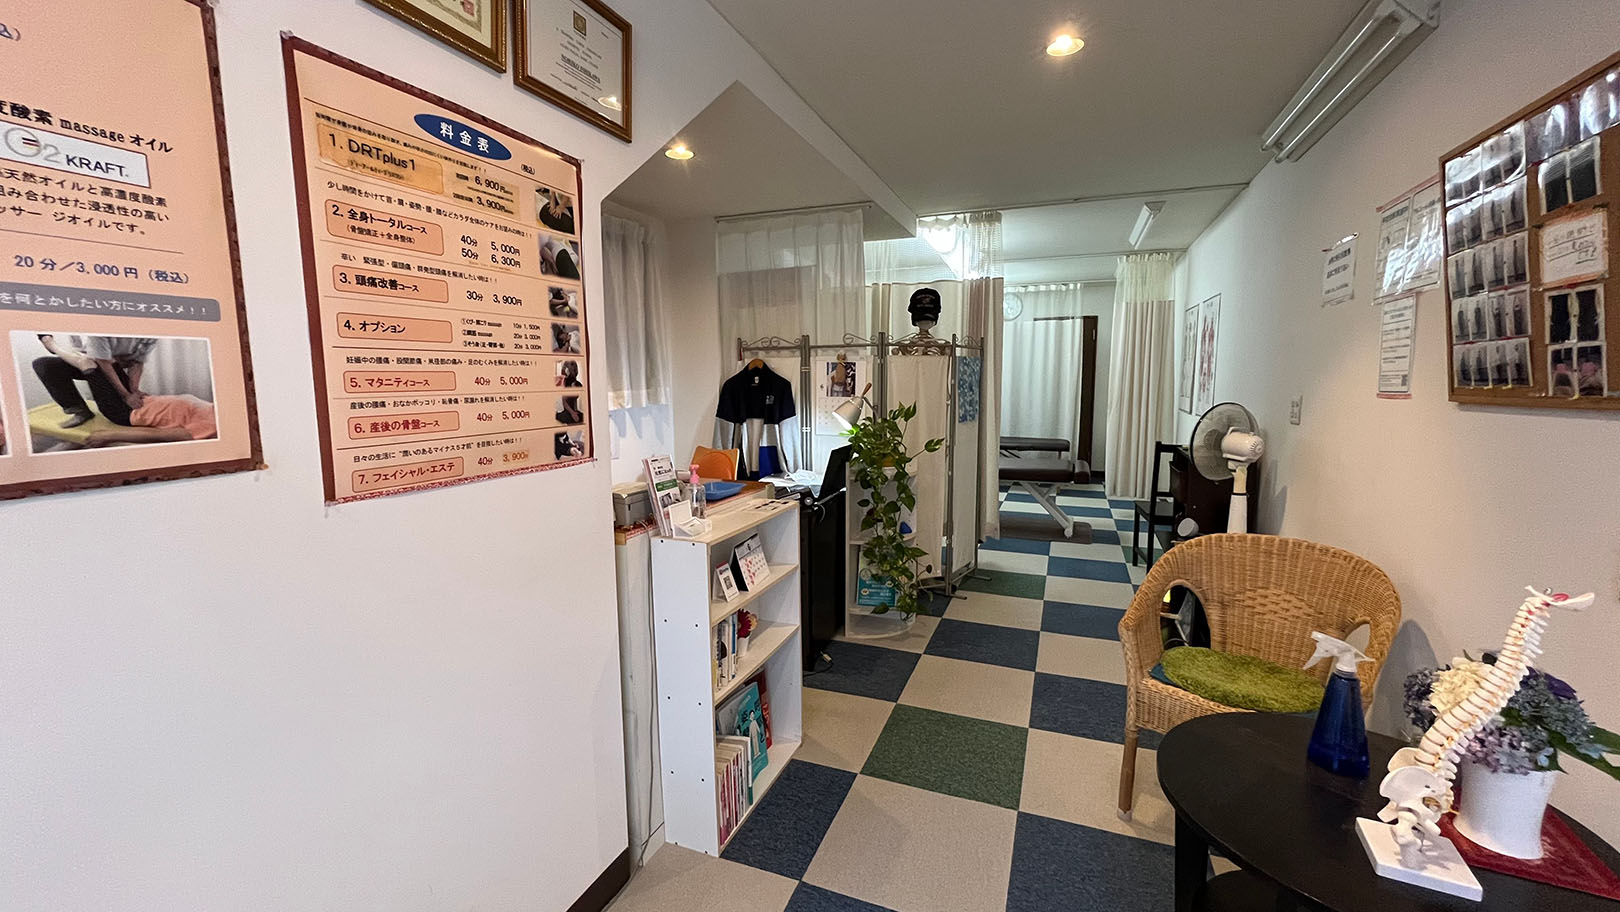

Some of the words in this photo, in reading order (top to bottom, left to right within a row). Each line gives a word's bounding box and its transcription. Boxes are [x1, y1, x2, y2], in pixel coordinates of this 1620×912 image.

[59, 118, 125, 143] massage
[129, 134, 173, 153] オイル
[439, 121, 490, 154] 料金表
[347, 208, 428, 235] 全身トータルコース
[355, 274, 420, 293] 頭痛改善コース
[359, 320, 406, 334] オプション
[365, 377, 430, 388] マタニティコース
[370, 419, 440, 434] 産後の骨盤コース
